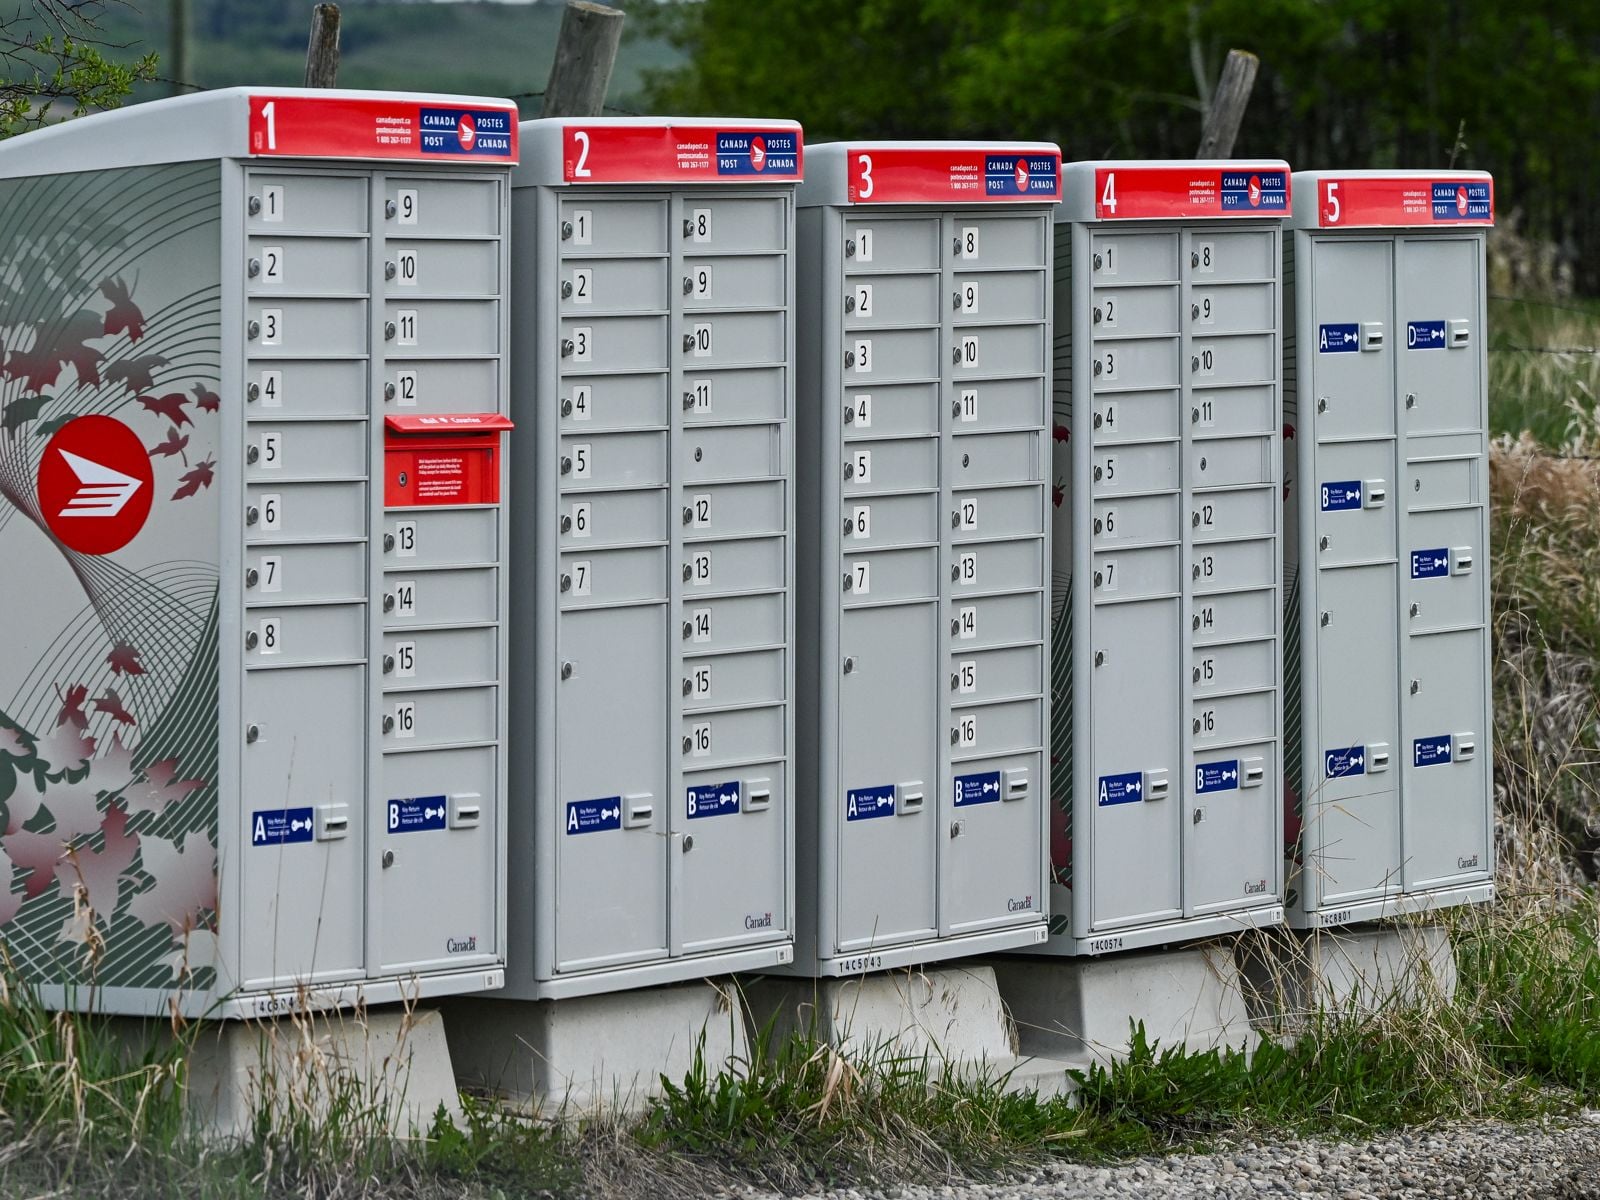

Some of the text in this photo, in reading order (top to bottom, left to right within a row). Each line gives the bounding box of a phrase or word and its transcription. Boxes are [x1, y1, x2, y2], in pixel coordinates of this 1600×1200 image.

[261, 102, 276, 150] 1
[424, 116, 456, 126] CANADA
[478, 118, 503, 128] POSTES
[425, 137, 443, 146] POST
[478, 139, 507, 149] CANADA
[720, 140, 748, 149] CANADA
[768, 140, 791, 148] POSTES
[574, 131, 591, 177] 2
[721, 160, 737, 168] POST
[768, 160, 794, 168] CANADA
[858, 154, 874, 199] 3
[988, 162, 1014, 170] CANADA
[1030, 162, 1051, 170] POSTES
[989, 181, 1004, 189] POST
[1031, 181, 1054, 189] CANADA
[1102, 173, 1117, 214] 4
[1434, 189, 1455, 197] CANADA
[1469, 189, 1486, 197] POSTES
[268, 191, 275, 215] 1
[403, 195, 413, 218] 9
[1224, 196, 1238, 204] POST
[1263, 196, 1284, 204] CANADA
[1327, 182, 1339, 223] 5
[1434, 206, 1448, 214] POST
[1469, 206, 1488, 214] CANADA
[578, 215, 584, 238] 1
[698, 214, 707, 236] 8
[861, 234, 866, 256] 1
[966, 232, 975, 254] 8
[267, 253, 277, 277] 2
[400, 255, 415, 279] 10
[1107, 248, 1112, 269] 1
[1203, 246, 1211, 267] 8
[577, 274, 586, 297] 2
[698, 271, 707, 293] 9
[860, 290, 868, 311] 2
[966, 287, 974, 308] 9
[1203, 298, 1211, 319] 9
[1106, 301, 1114, 322] 2
[266, 315, 276, 339] 3
[400, 316, 414, 339] 11
[1408, 325, 1416, 346] D
[577, 332, 586, 355] 3
[696, 328, 710, 351] 10
[1320, 328, 1328, 349] A
[859, 345, 867, 367] 3
[964, 341, 976, 362] 10
[1201, 350, 1213, 370] 10
[1106, 353, 1114, 375] 3
[265, 376, 276, 400] 4
[400, 376, 414, 399] 12
[696, 385, 708, 407] 11
[576, 391, 586, 414] 4
[858, 400, 867, 421] 4
[964, 395, 974, 416] 11
[1202, 401, 1212, 421] 11
[1105, 406, 1114, 427] 4
[266, 438, 275, 462] 5
[577, 449, 586, 472] 5
[859, 456, 866, 477] 5
[1107, 459, 1114, 480] 5
[1322, 487, 1329, 507] B
[265, 499, 275, 524] 6
[577, 508, 586, 531] 6
[695, 499, 709, 522] 12
[963, 503, 975, 525] 12
[1202, 505, 1213, 525] 12
[857, 511, 866, 533] 6
[1106, 511, 1114, 533] 6
[399, 526, 414, 550] 13
[266, 561, 276, 585] 7
[695, 556, 709, 579] 13
[962, 557, 974, 579] 13
[1106, 564, 1114, 585] 7
[1202, 556, 1213, 577] 13
[1413, 555, 1419, 576] E
[577, 566, 586, 589] 7
[857, 567, 865, 588] 7
[397, 586, 413, 610] 14
[695, 613, 710, 636] 14
[961, 611, 974, 633] 14
[1201, 607, 1214, 628] 14
[265, 624, 275, 648] 8
[398, 646, 413, 670] 15
[961, 666, 974, 687] 15
[1202, 659, 1214, 680] 15
[695, 670, 709, 693] 15
[397, 707, 413, 731] 16
[1202, 710, 1214, 732] 16
[695, 727, 709, 750] 16
[961, 720, 974, 742] 16
[1327, 754, 1334, 775] C
[1416, 743, 1421, 764] F
[1197, 768, 1204, 790] B
[955, 780, 963, 803] B
[1100, 780, 1108, 802] A
[688, 791, 697, 815] B
[848, 793, 858, 817] A
[390, 804, 399, 829] B
[568, 806, 579, 830] A
[254, 815, 266, 841] A
[1458, 855, 1478, 869] Canada
[1244, 880, 1266, 894] Canada
[1008, 896, 1032, 912] Canada
[745, 912, 772, 930] Canada
[447, 936, 476, 953] Canada
[1090, 938, 1123, 952] T4C0574
[839, 956, 882, 973] T4C5043
